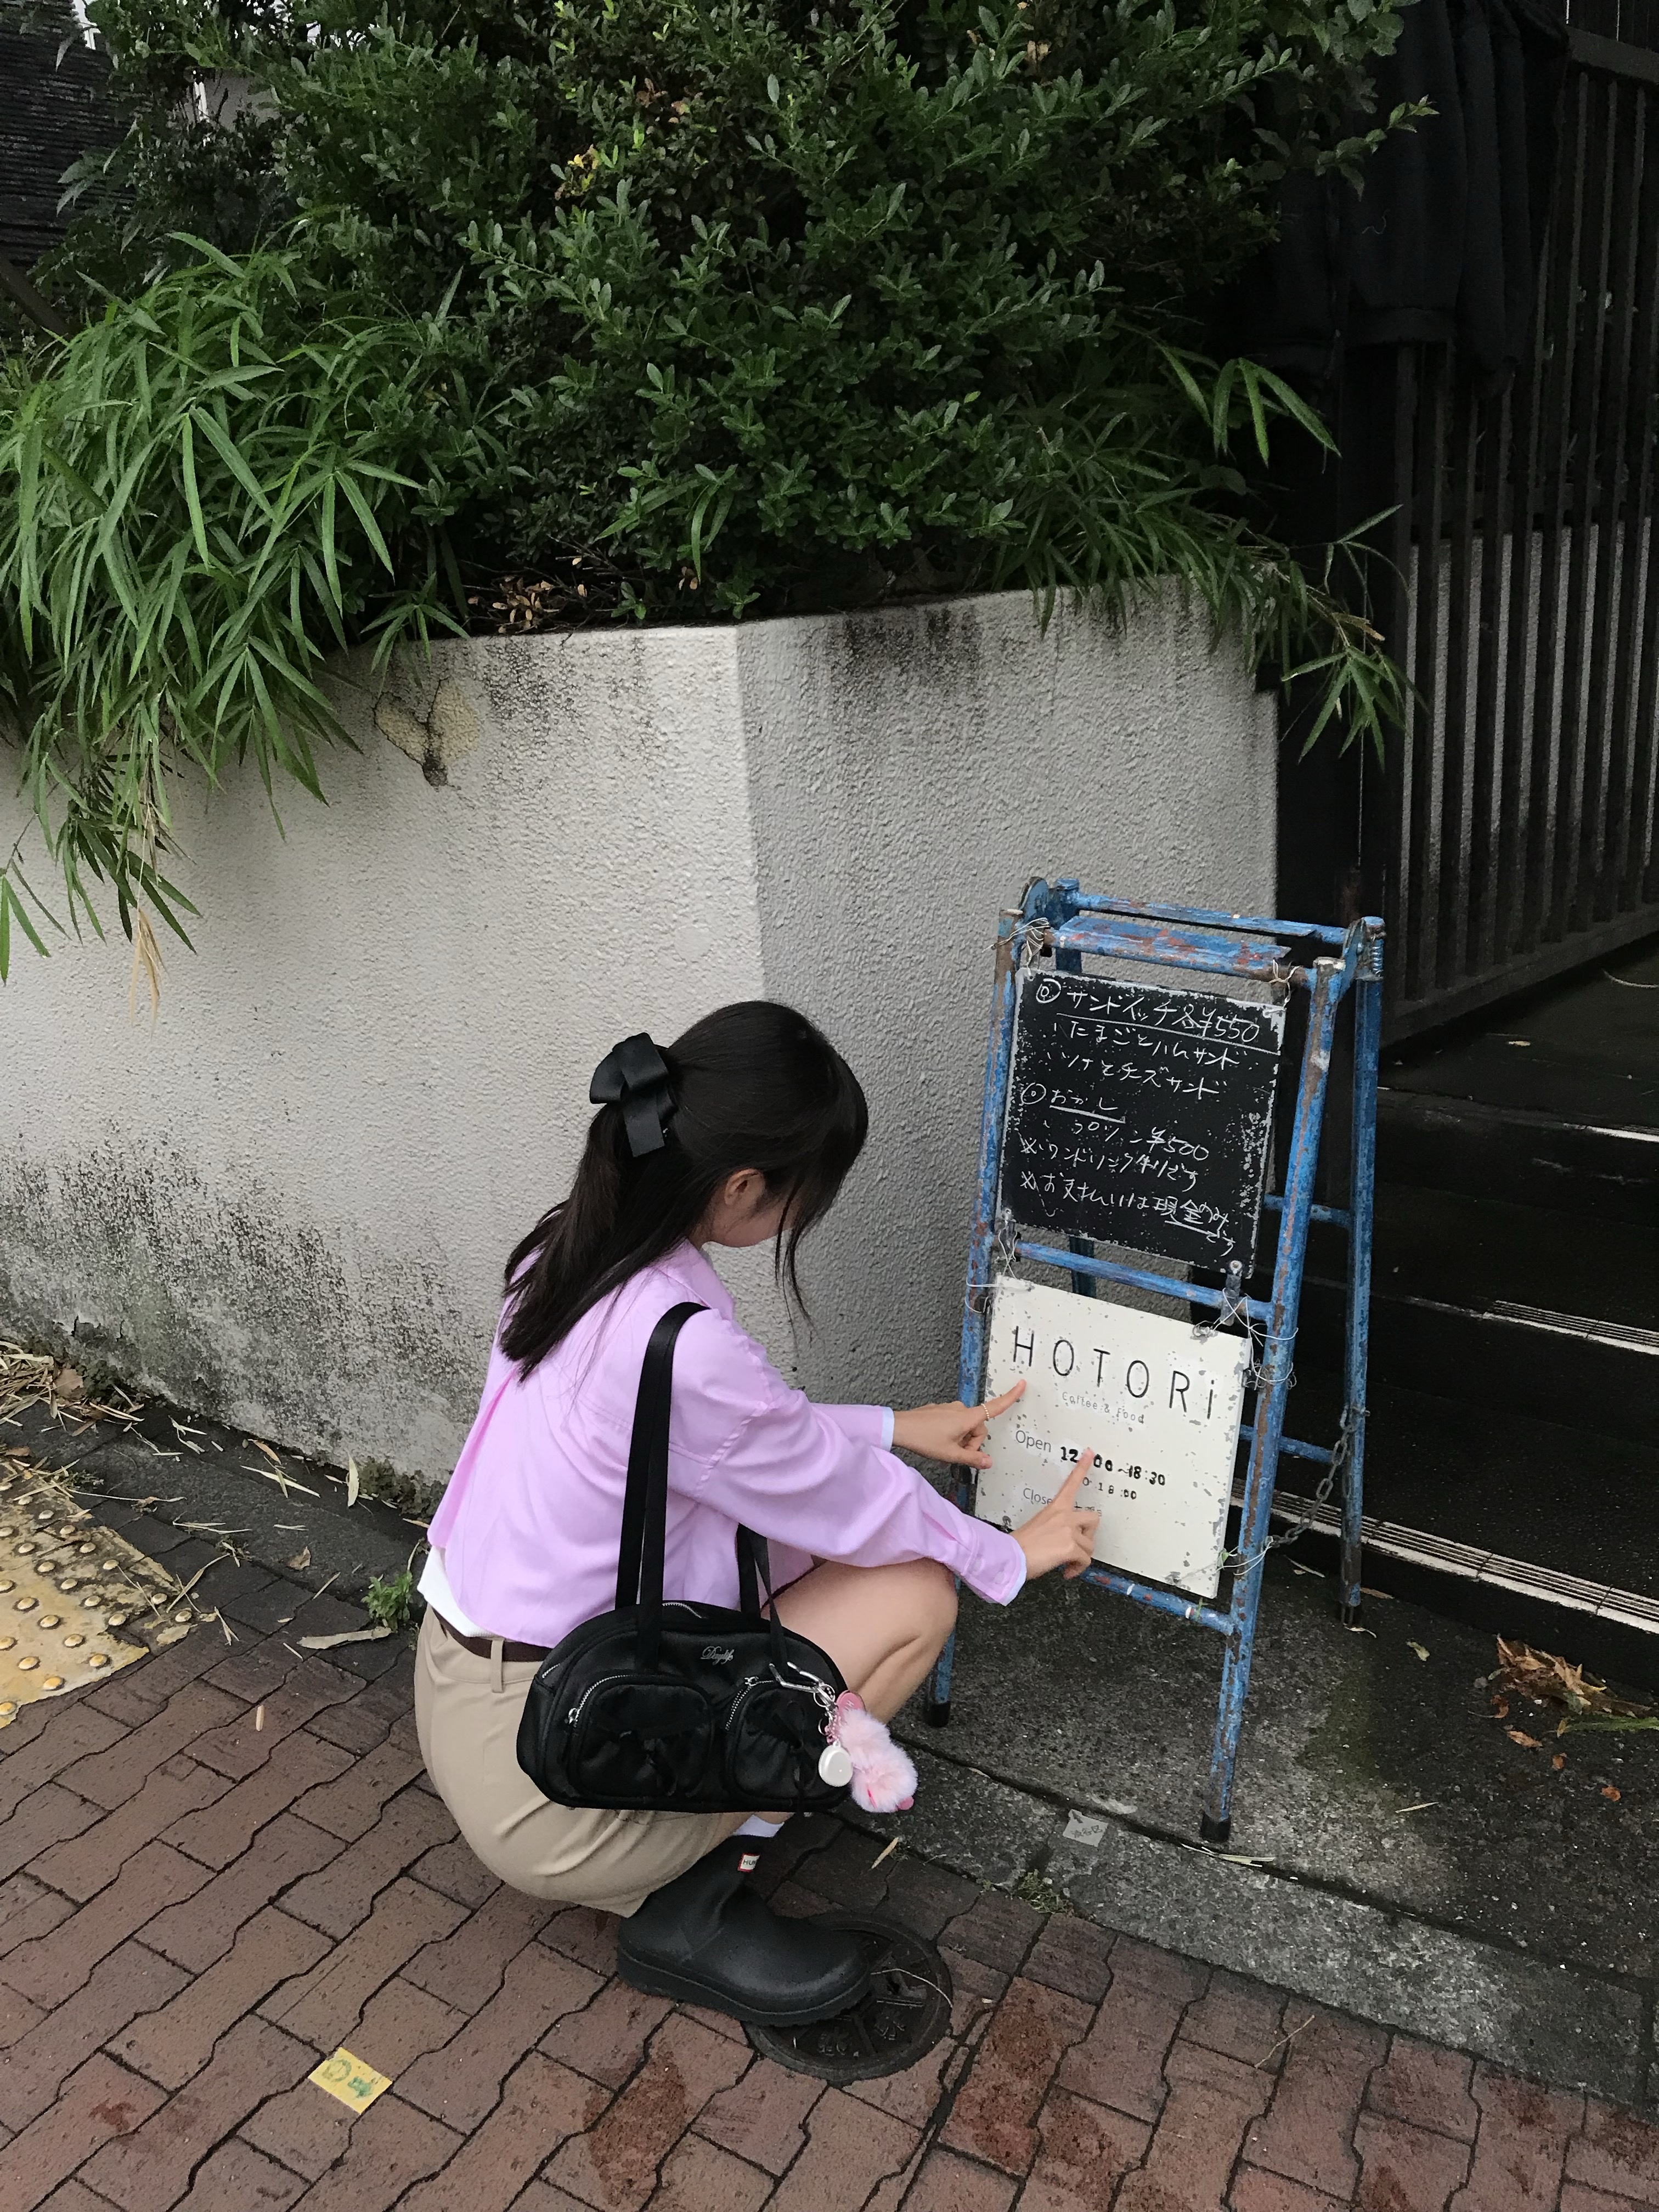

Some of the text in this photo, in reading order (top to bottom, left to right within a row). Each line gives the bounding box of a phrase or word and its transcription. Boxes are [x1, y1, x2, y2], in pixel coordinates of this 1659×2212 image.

[1050, 1089, 1118, 1110] おかし
[1015, 1430, 1052, 1453] Open
